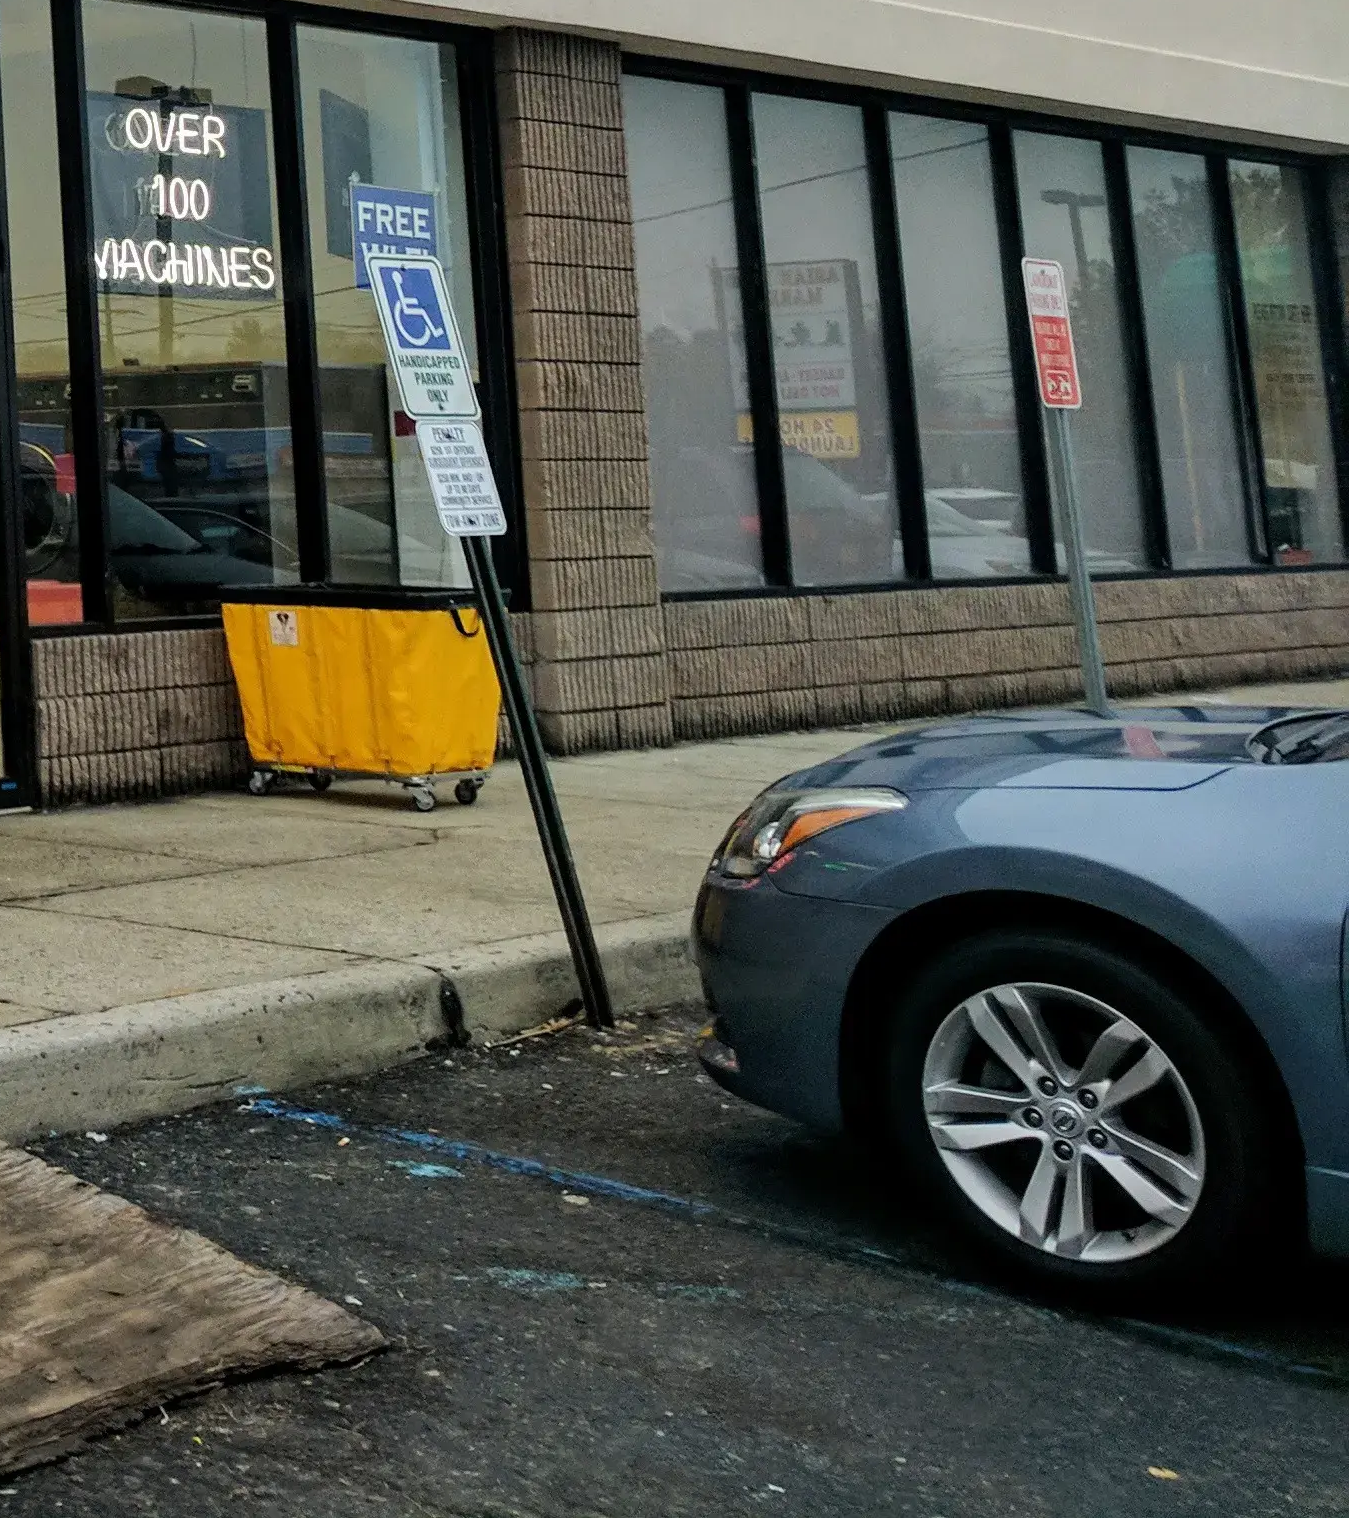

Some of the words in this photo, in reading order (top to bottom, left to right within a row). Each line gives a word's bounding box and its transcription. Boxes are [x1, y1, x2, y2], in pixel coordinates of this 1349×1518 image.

[125, 108, 226, 159] OVER
[151, 174, 210, 220] 100
[357, 201, 430, 240] FREE
[93, 238, 275, 289] MACHINES
[398, 355, 460, 369] HANDICAPPED
[414, 372, 454, 386] PARKING
[426, 389, 449, 403] ONLY
